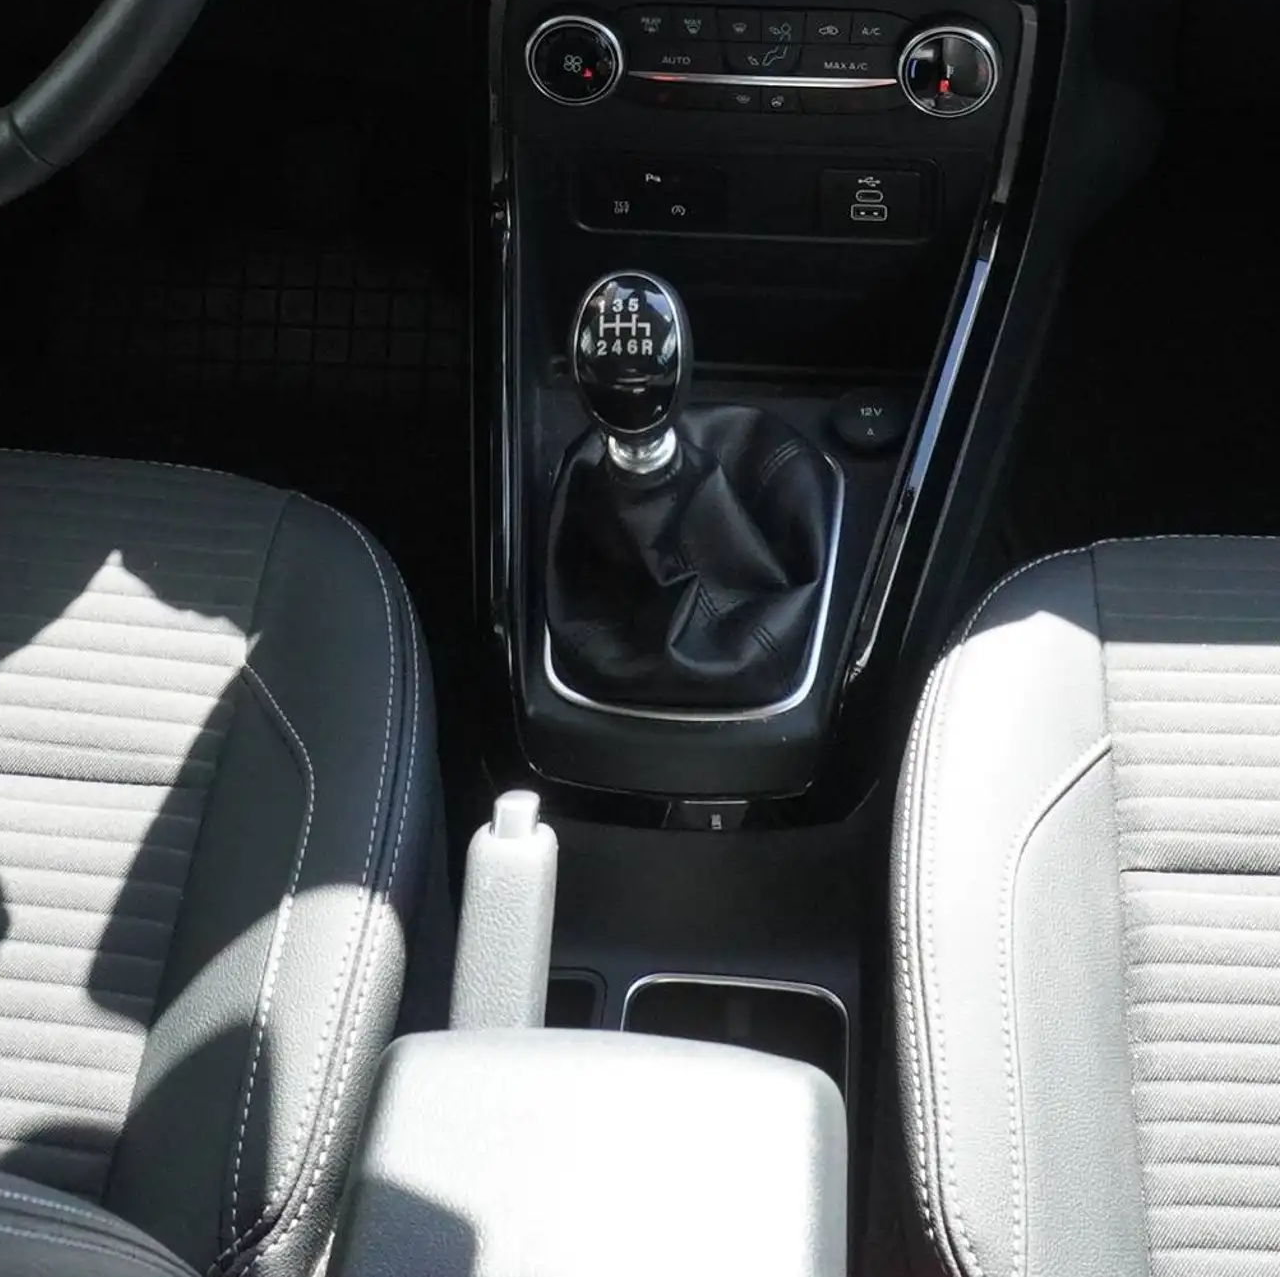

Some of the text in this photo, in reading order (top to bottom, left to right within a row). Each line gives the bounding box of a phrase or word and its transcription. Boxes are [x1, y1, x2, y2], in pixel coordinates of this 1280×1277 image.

[862, 27, 881, 35] A/C
[661, 56, 691, 64] AUTO
[823, 61, 868, 71] MAX A/C
[599, 298, 639, 313] 1 3 5
[597, 339, 652, 355] 2 4 6 R
[860, 407, 882, 416] 12V
